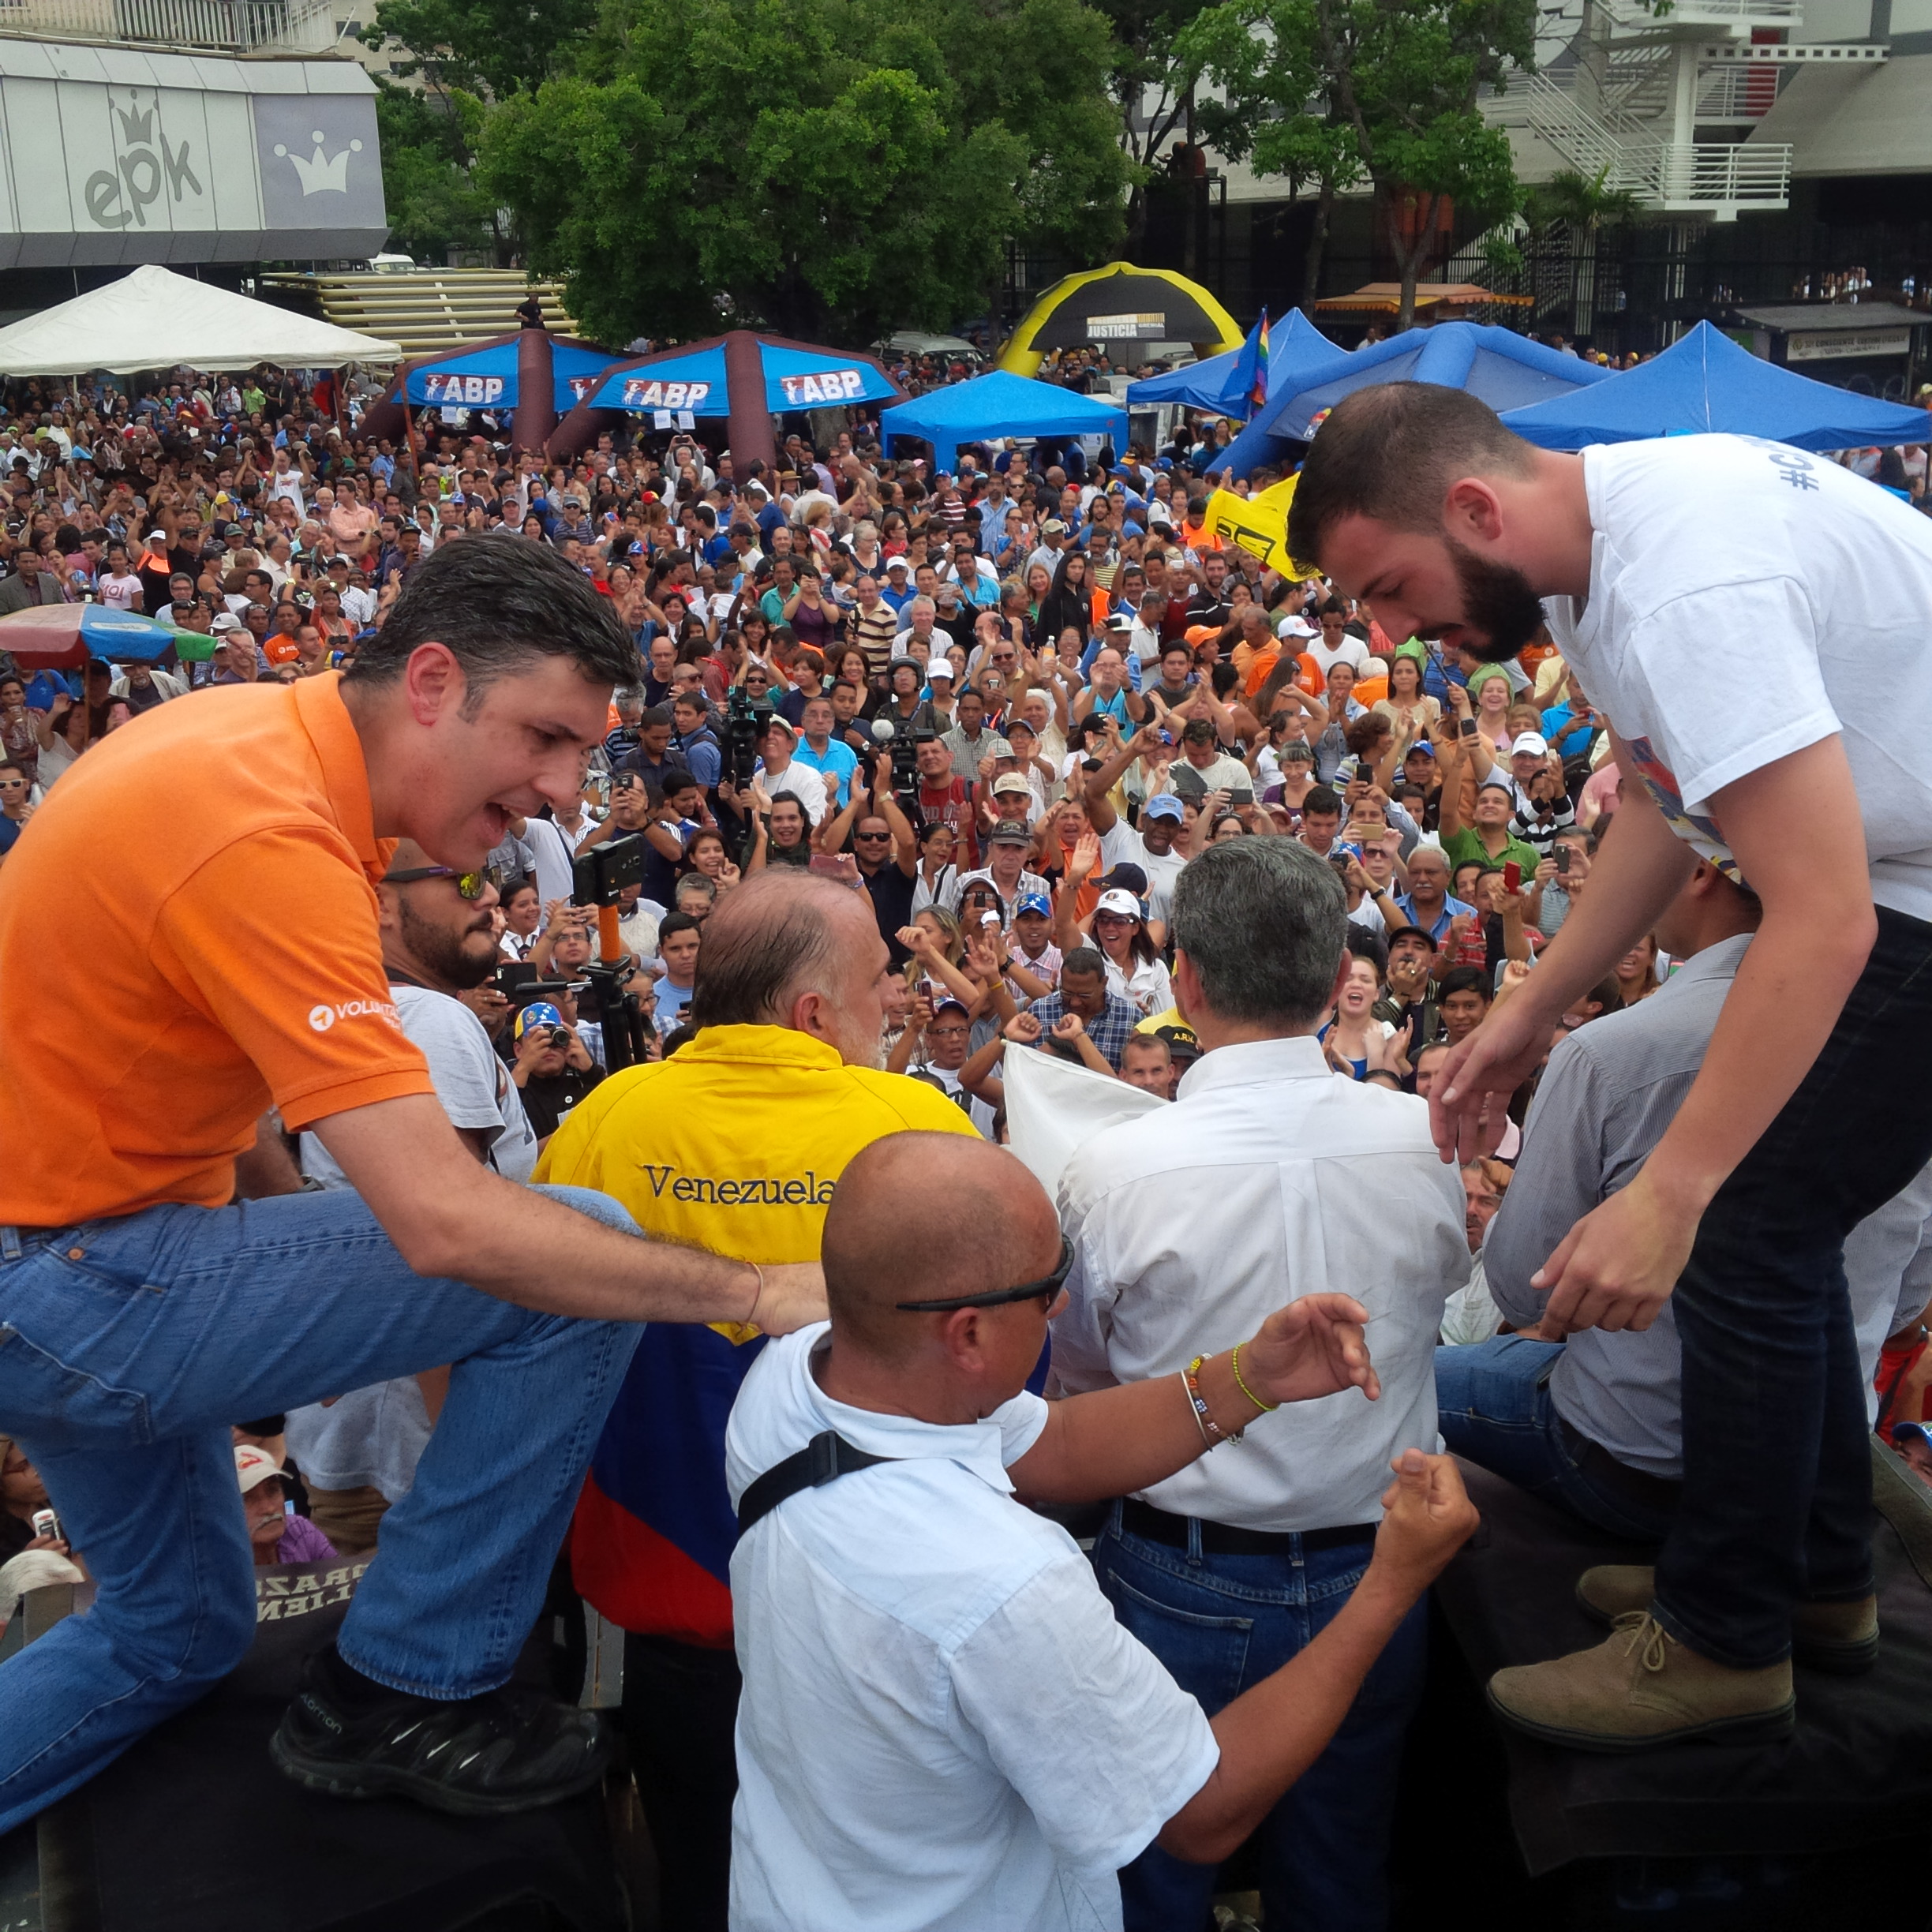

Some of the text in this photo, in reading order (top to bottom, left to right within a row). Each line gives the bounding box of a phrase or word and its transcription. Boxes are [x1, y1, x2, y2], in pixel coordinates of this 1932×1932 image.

[84, 133, 203, 229] epk
[1088, 324, 1137, 338] JUSTICIA
[442, 376, 503, 403] ABP
[640, 381, 709, 408] ABP
[803, 370, 862, 402] ABP
[642, 1164, 838, 1205] Venezuela
